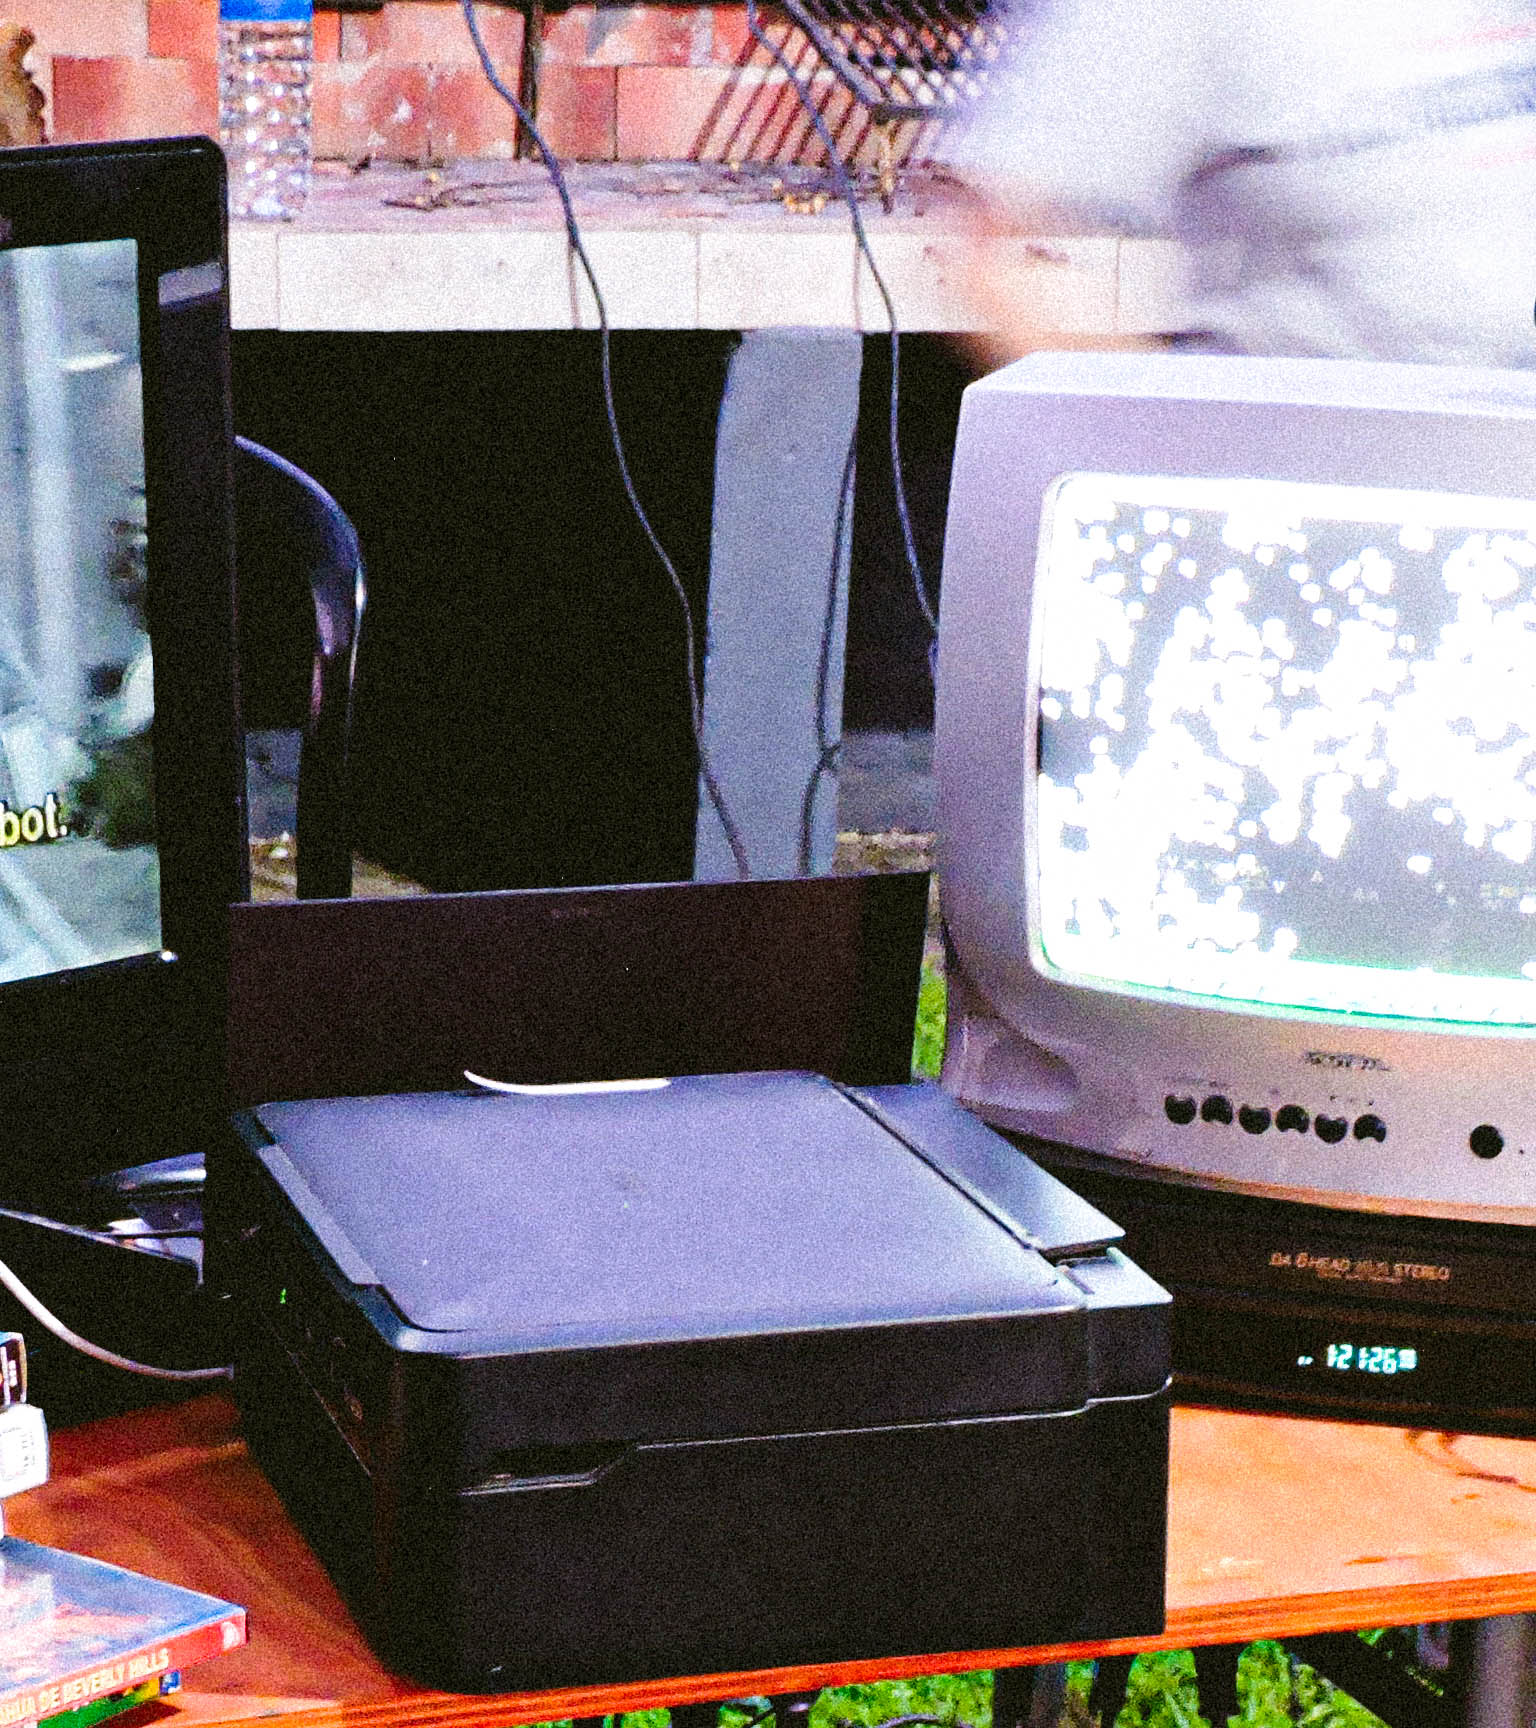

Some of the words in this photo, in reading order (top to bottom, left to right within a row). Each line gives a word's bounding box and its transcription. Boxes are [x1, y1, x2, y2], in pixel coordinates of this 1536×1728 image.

[38, 1687, 61, 1713] DE
[63, 1663, 127, 1706] BEVERLY
[128, 1647, 170, 1677] HILLS
